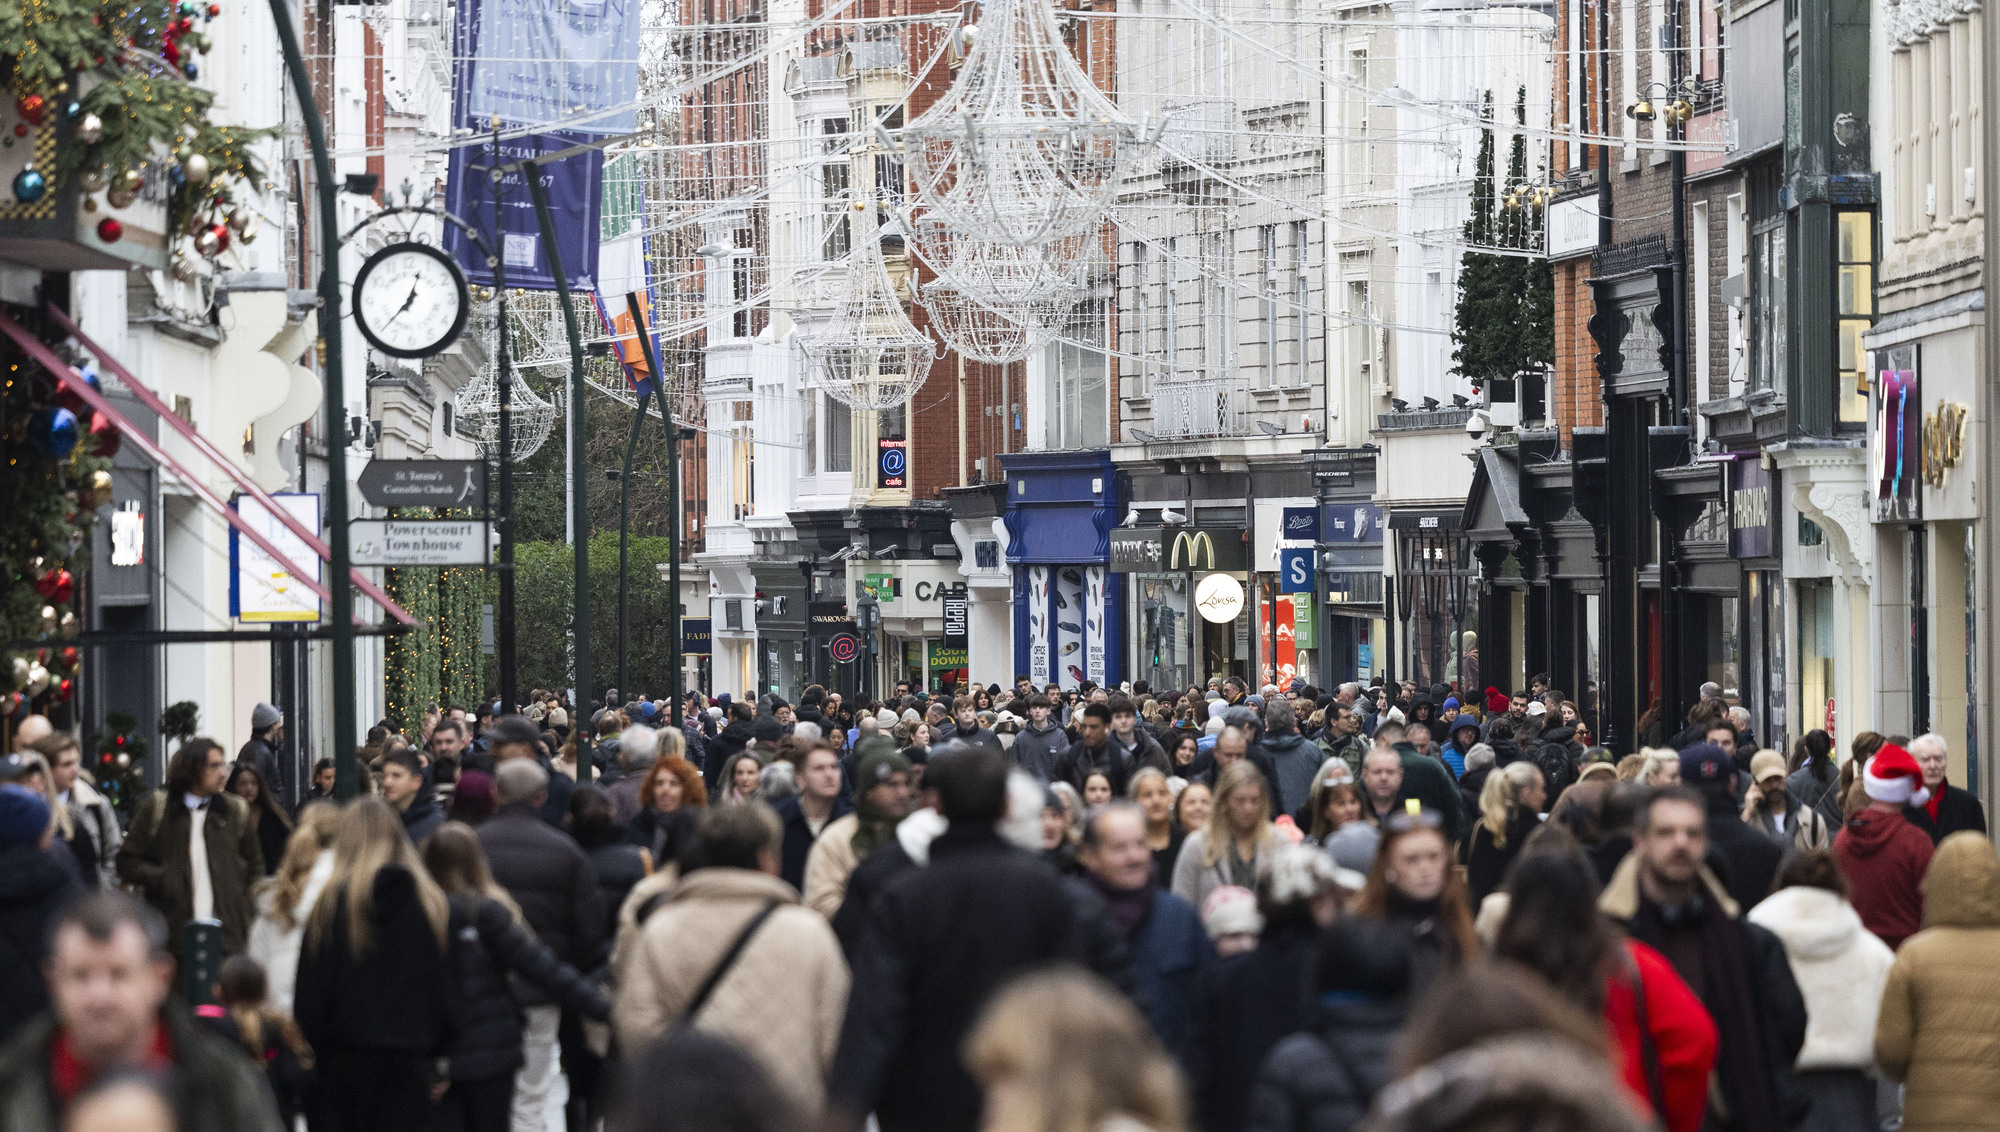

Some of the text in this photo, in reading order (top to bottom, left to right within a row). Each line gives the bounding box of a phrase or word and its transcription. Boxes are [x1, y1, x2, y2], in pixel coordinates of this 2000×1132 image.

[880, 440, 907, 448] internet
[395, 471, 406, 481] St.
[885, 478, 903, 486] cafe
[423, 484, 455, 494] Church
[1287, 515, 1314, 530] Boots
[384, 522, 473, 536] Powerscourt
[385, 538, 463, 551] Townhouse
[1198, 588, 1239, 610] Lovisa
[1033, 646, 1046, 656] OFFICE
[1033, 656, 1045, 666] LOVES
[1034, 667, 1048, 677] DUBLIN
